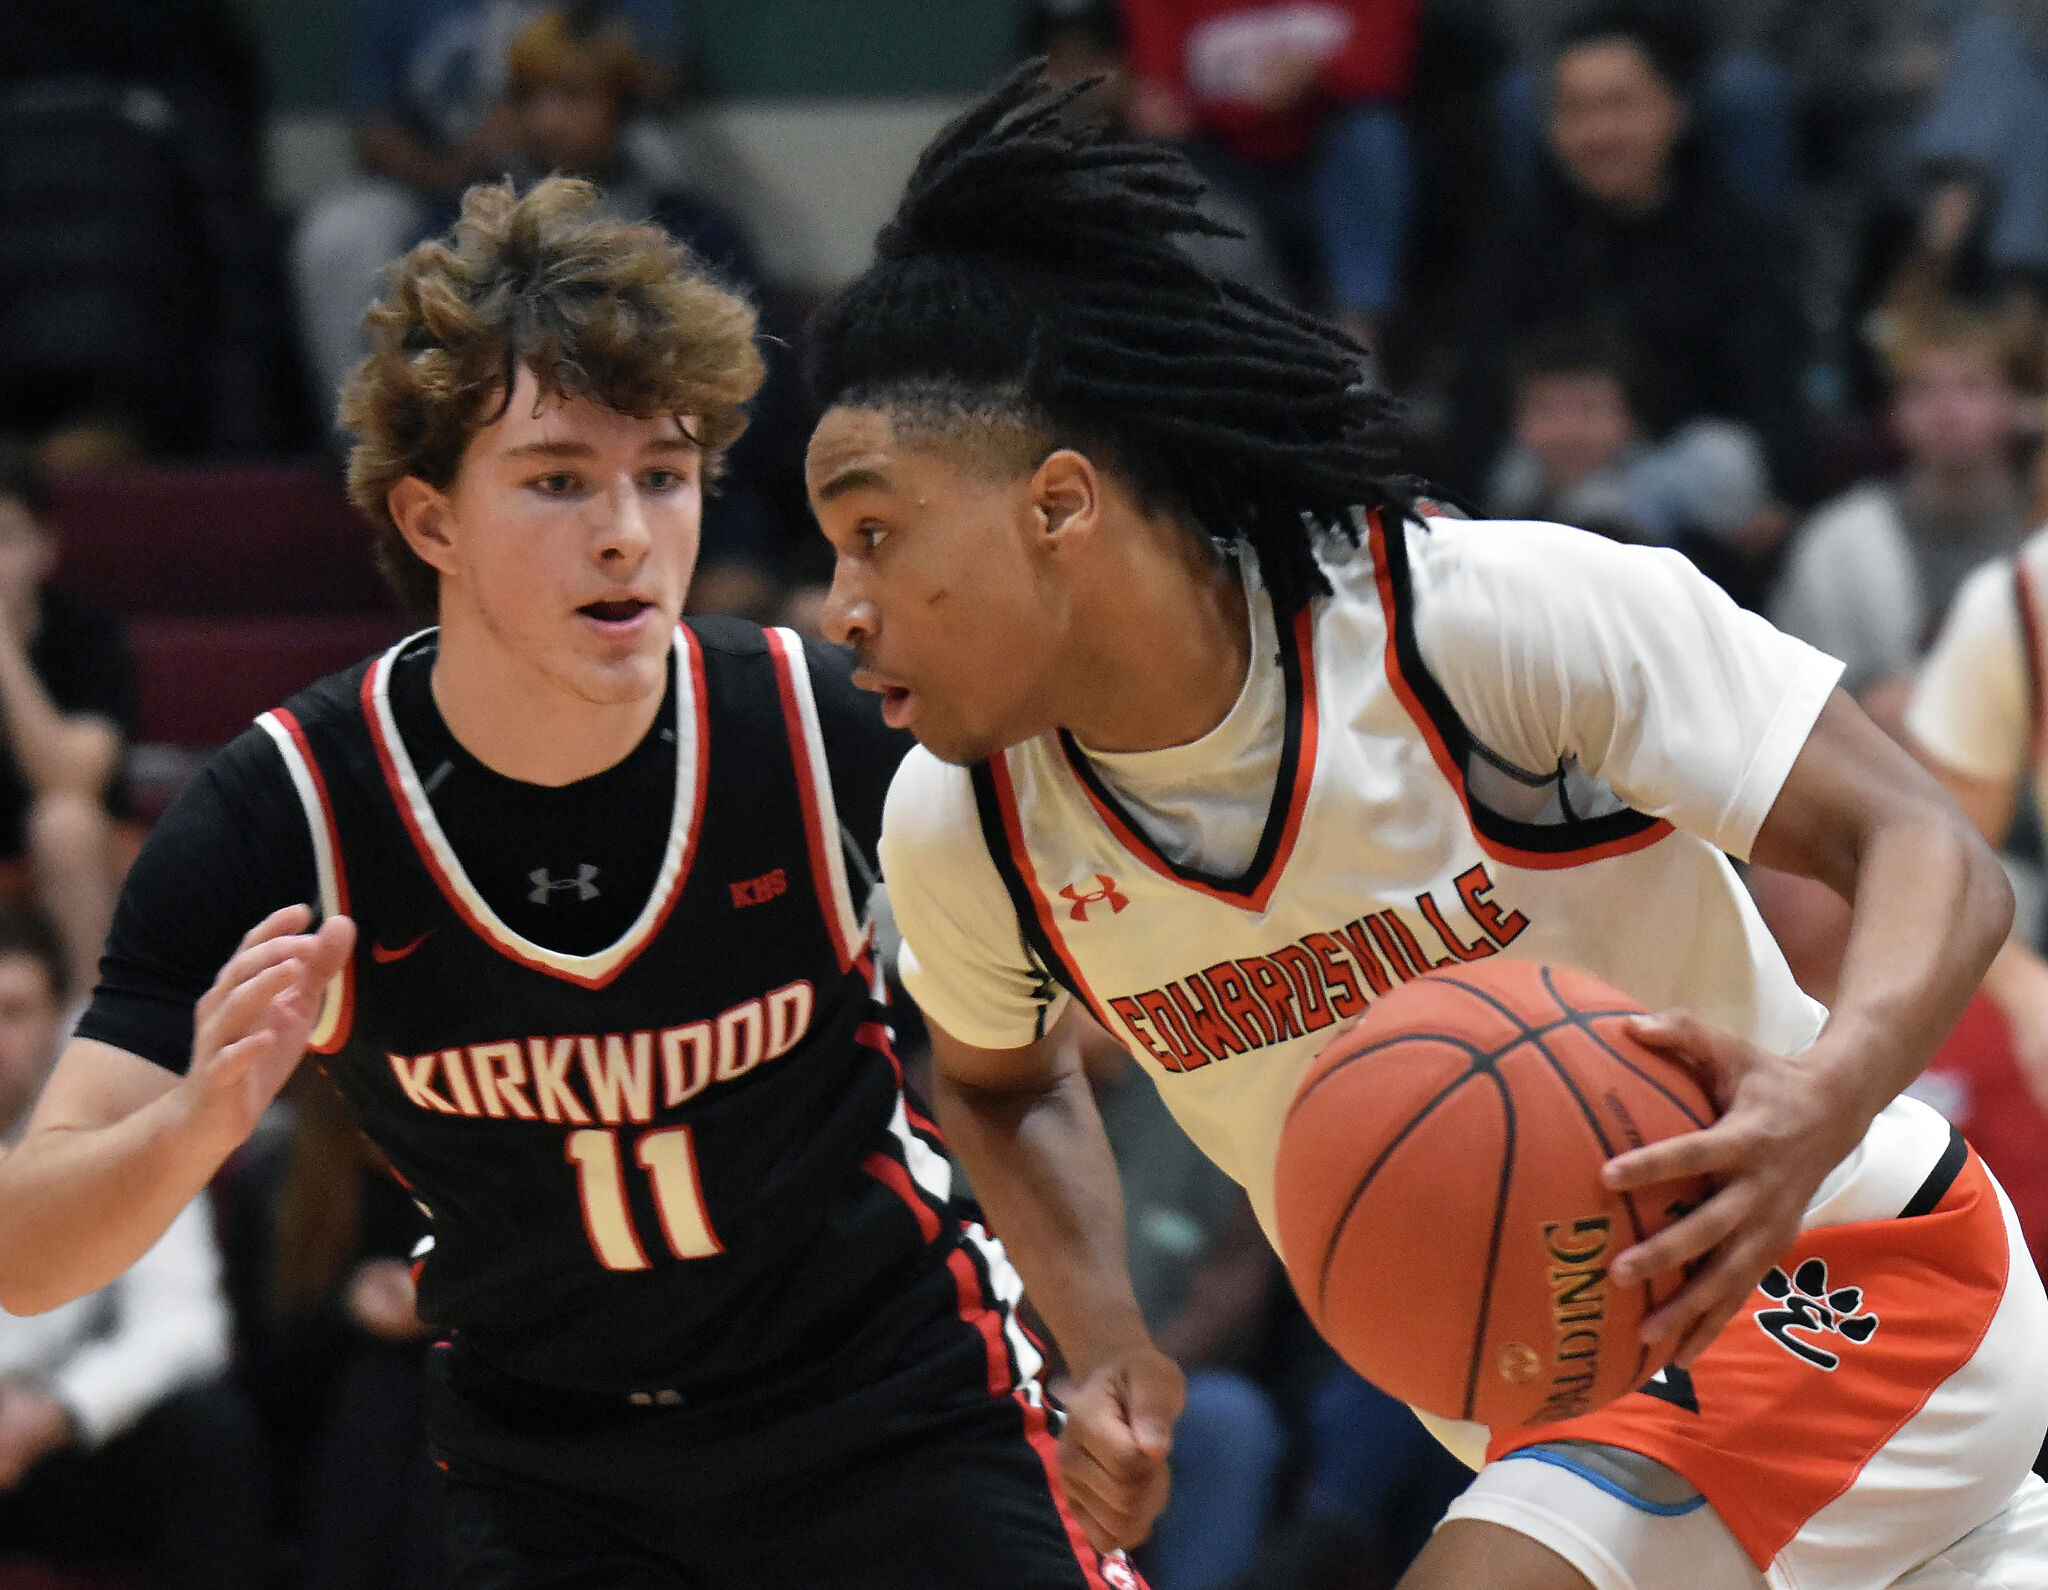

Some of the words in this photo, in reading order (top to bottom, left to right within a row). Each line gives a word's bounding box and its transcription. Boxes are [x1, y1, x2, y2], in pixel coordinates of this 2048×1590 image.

[1107, 862, 1531, 1073] EDWARDSVILLE
[387, 979, 815, 1126] KIRKWOOD
[564, 1123, 726, 1271] 11
